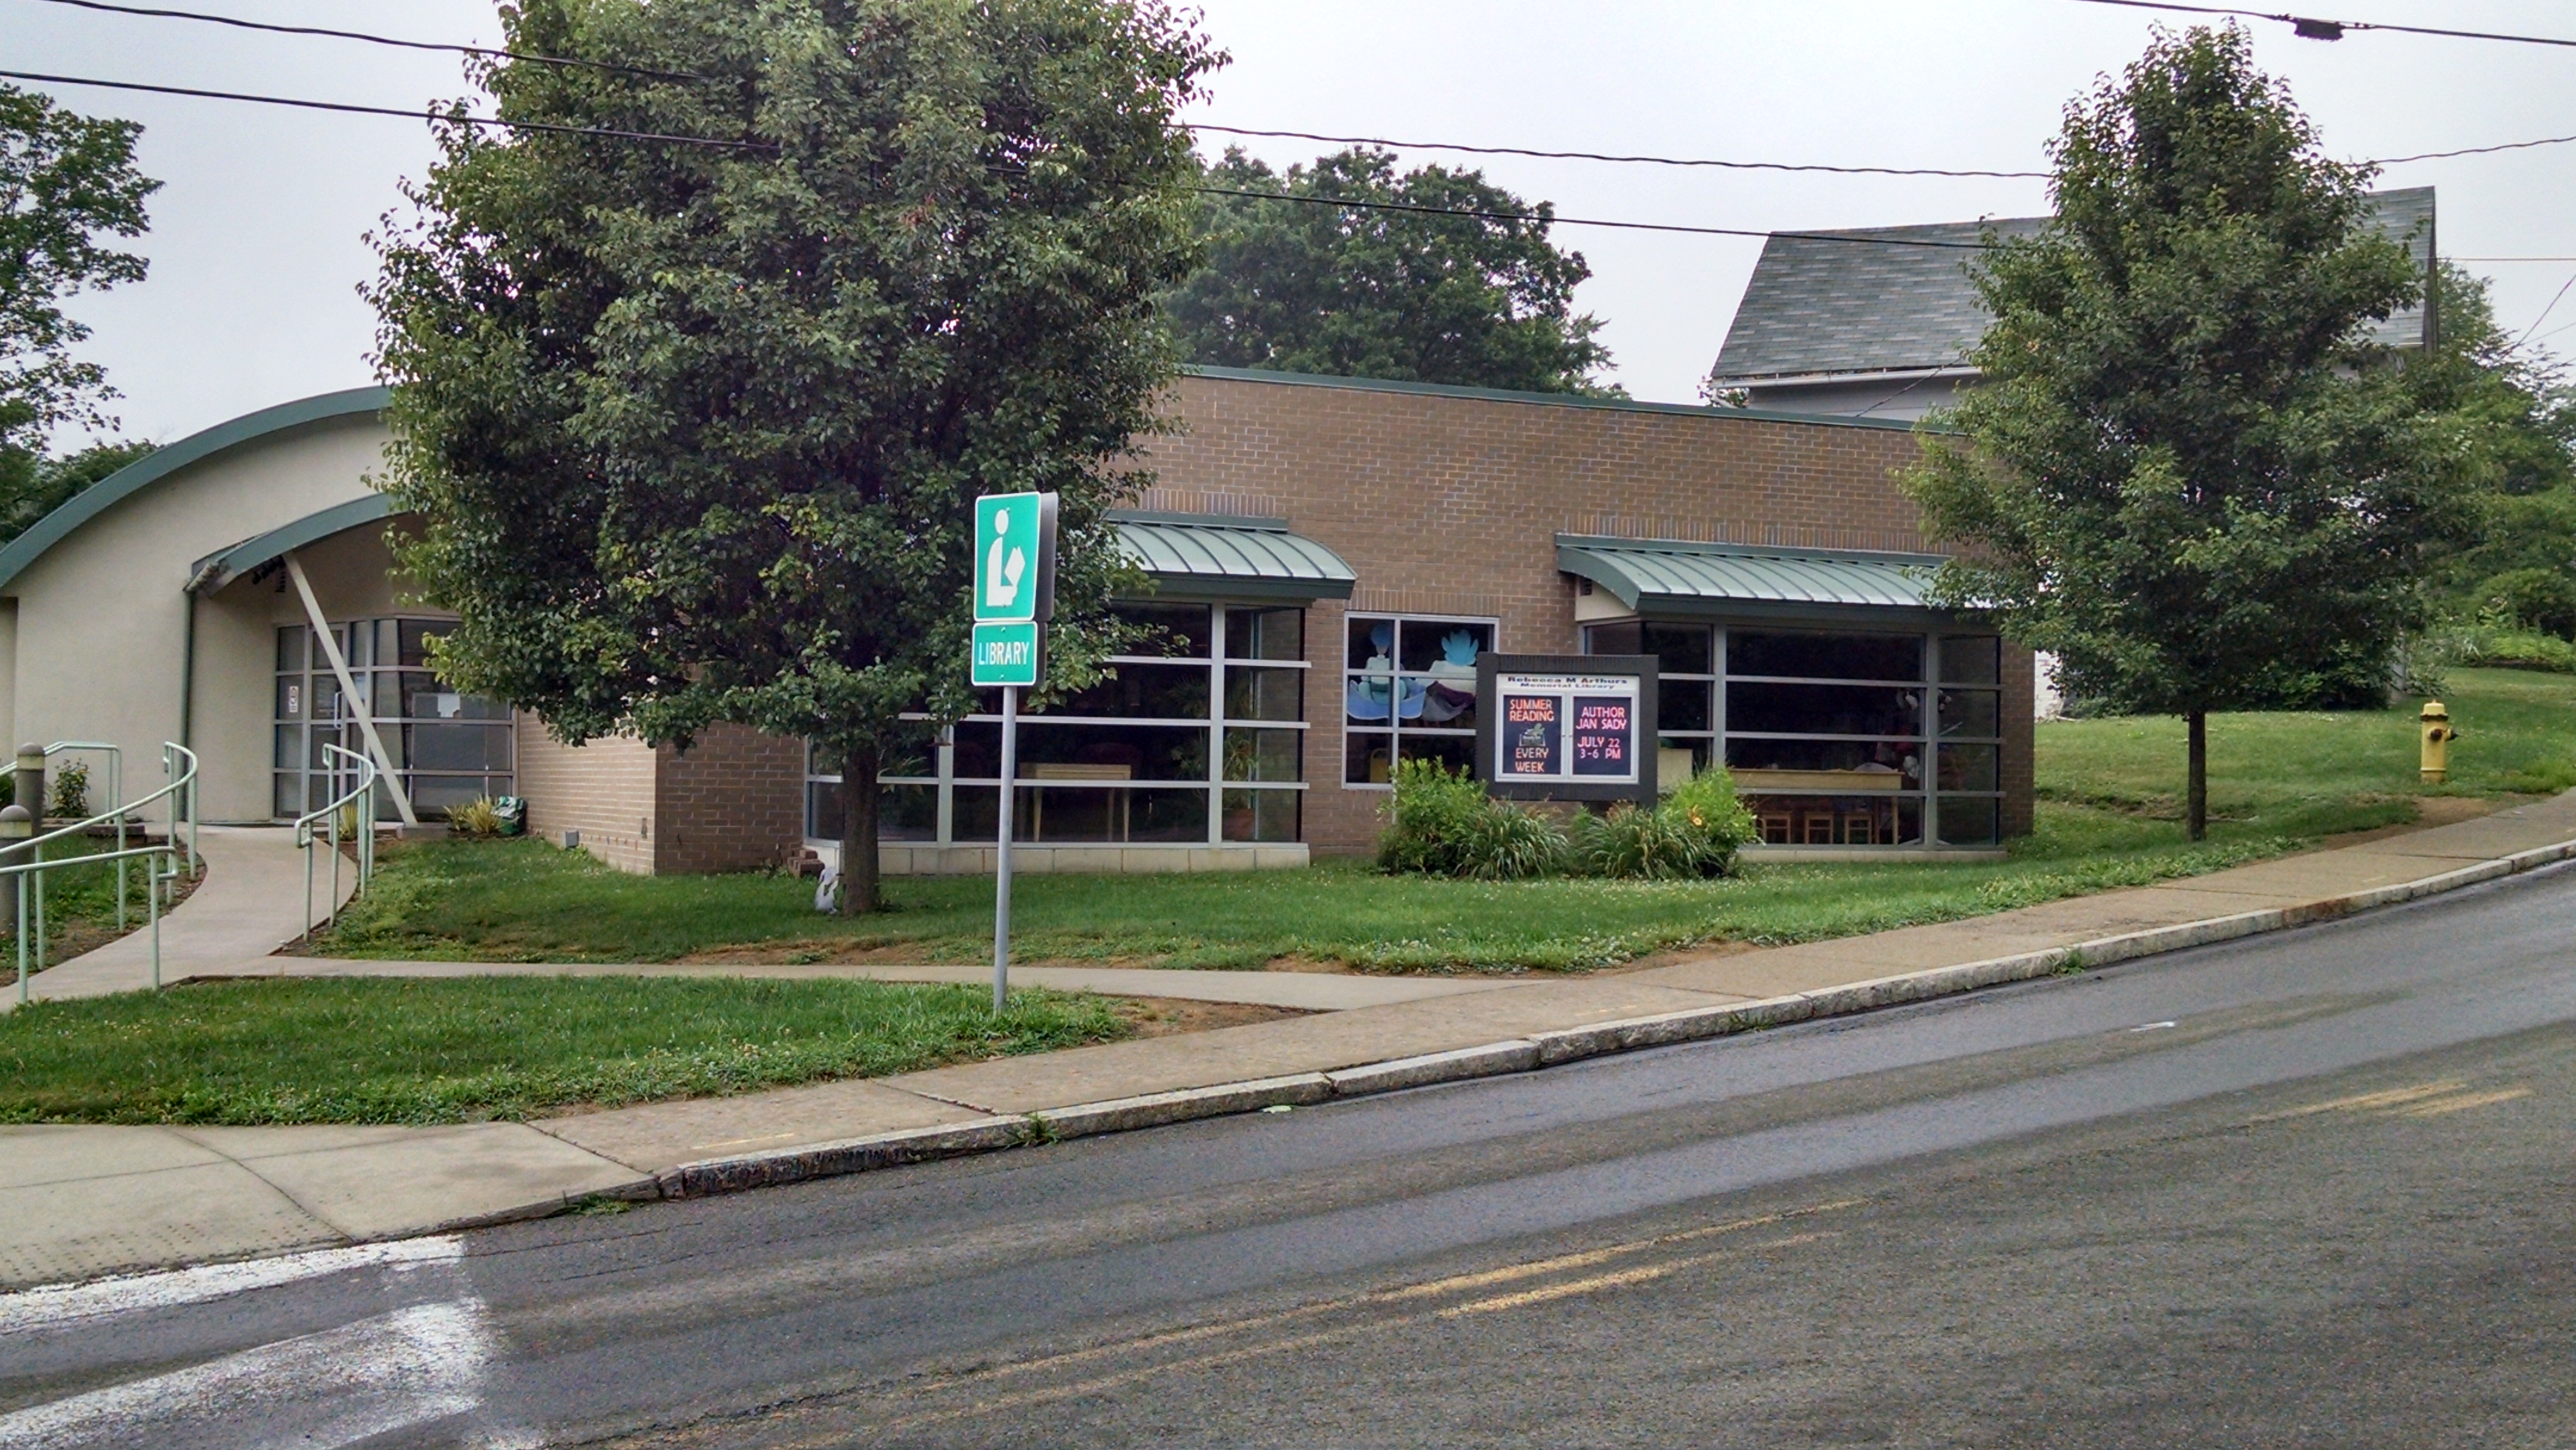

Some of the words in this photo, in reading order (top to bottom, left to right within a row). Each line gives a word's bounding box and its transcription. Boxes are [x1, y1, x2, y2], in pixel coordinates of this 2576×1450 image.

[979, 642, 1029, 665] LIBRARY
[1510, 699, 1552, 709] SUMMER
[1509, 711, 1555, 721] READING
[1581, 707, 1625, 718] AUTHOR
[1576, 718, 1597, 729] JAN
[1601, 718, 1627, 729] SADY
[1577, 736, 1605, 747] JULY
[1608, 739, 1620, 748] 22
[1515, 748, 1549, 758] EVERY
[1580, 749, 1599, 758] 3-6
[1605, 748, 1621, 759] PM
[1515, 761, 1544, 773] WEEK
